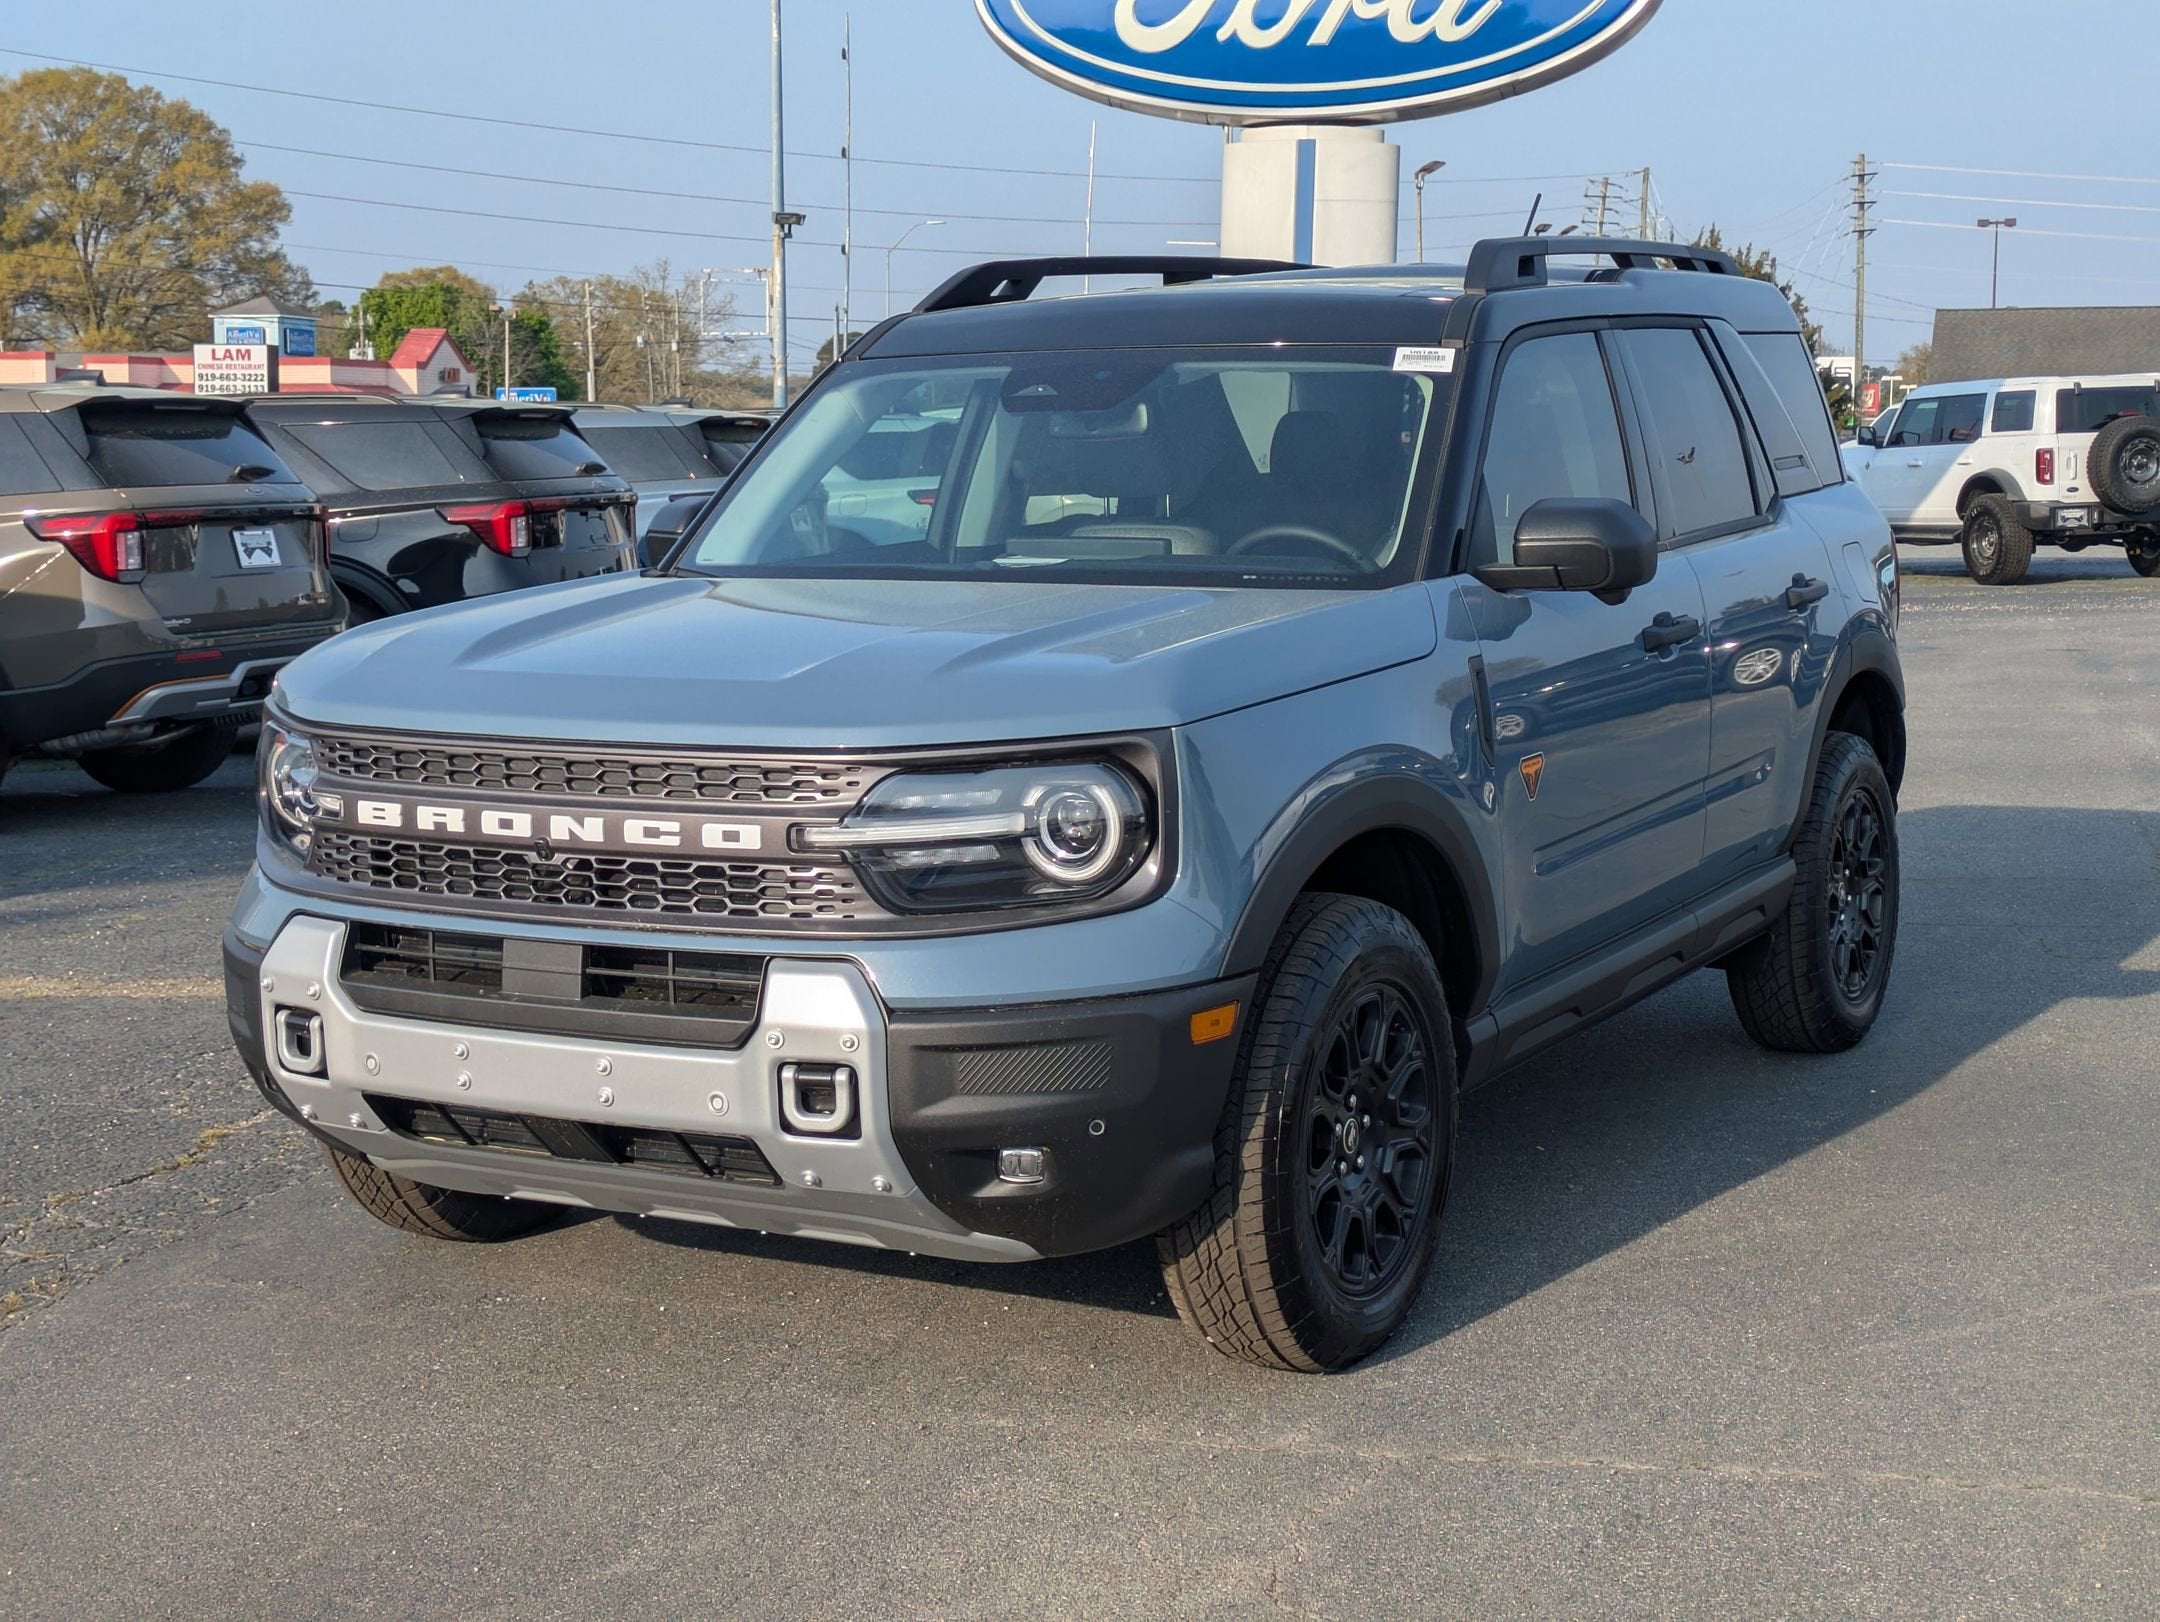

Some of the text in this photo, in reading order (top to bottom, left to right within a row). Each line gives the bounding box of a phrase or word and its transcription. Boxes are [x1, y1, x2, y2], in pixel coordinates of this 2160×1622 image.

[211, 348, 251, 361] LAM
[198, 373, 265, 382] 919-663-3222
[198, 384, 265, 393] 919-663-3133
[357, 800, 762, 849] BRONCO
